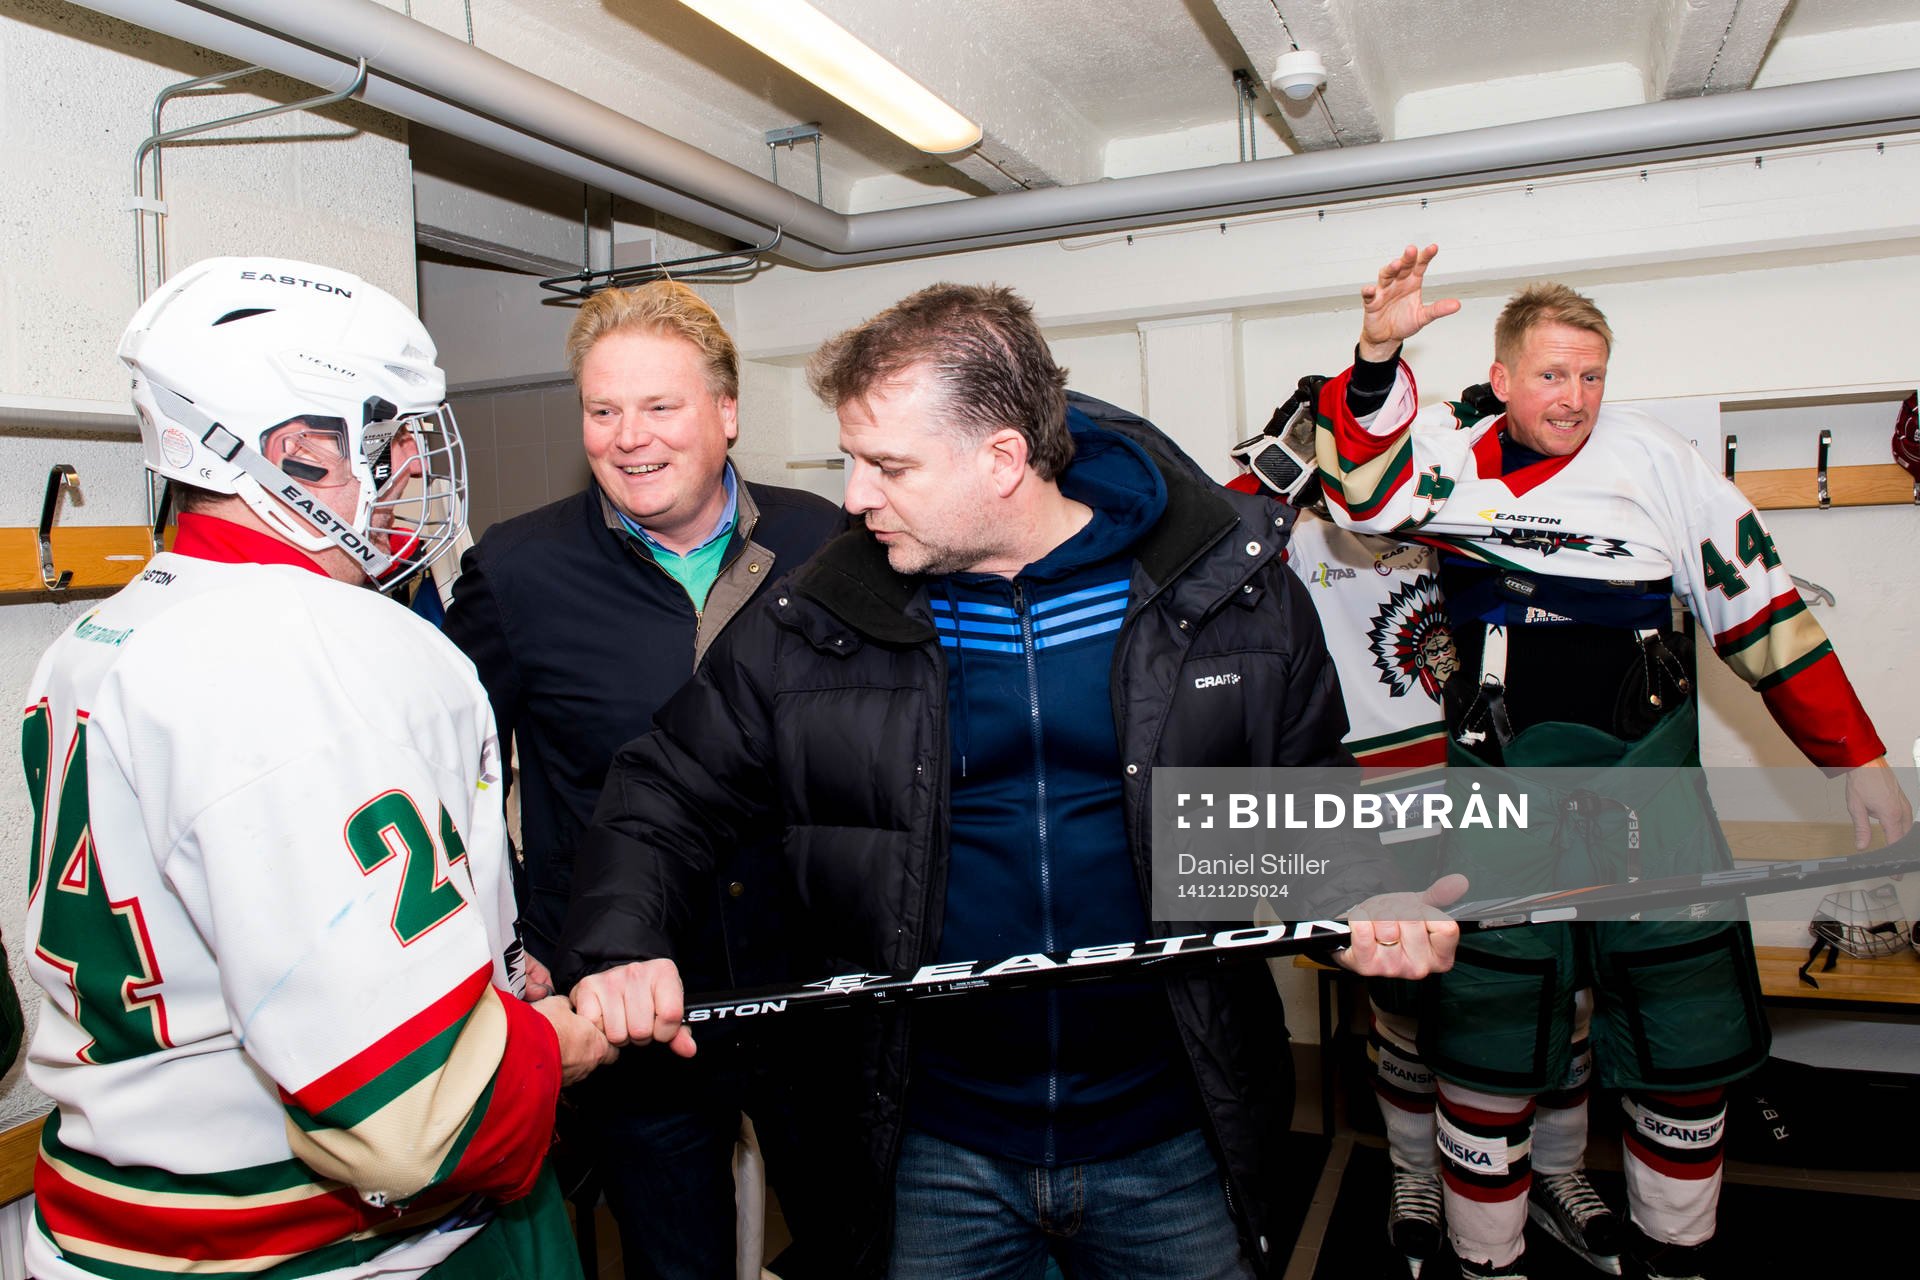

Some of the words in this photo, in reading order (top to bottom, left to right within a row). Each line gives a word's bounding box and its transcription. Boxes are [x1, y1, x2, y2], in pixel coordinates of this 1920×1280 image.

[240, 271, 353, 299] EASTON
[281, 485, 376, 562] EASTON
[1494, 513, 1562, 525] EASTON
[1382, 545, 1409, 560] EAST
[1700, 508, 1783, 601] 44
[1195, 673, 1231, 689] CRAFT
[681, 1000, 788, 1023] STON
[1644, 1116, 1724, 1142] SKANSKA
[1438, 1125, 1492, 1167] ANSKA
